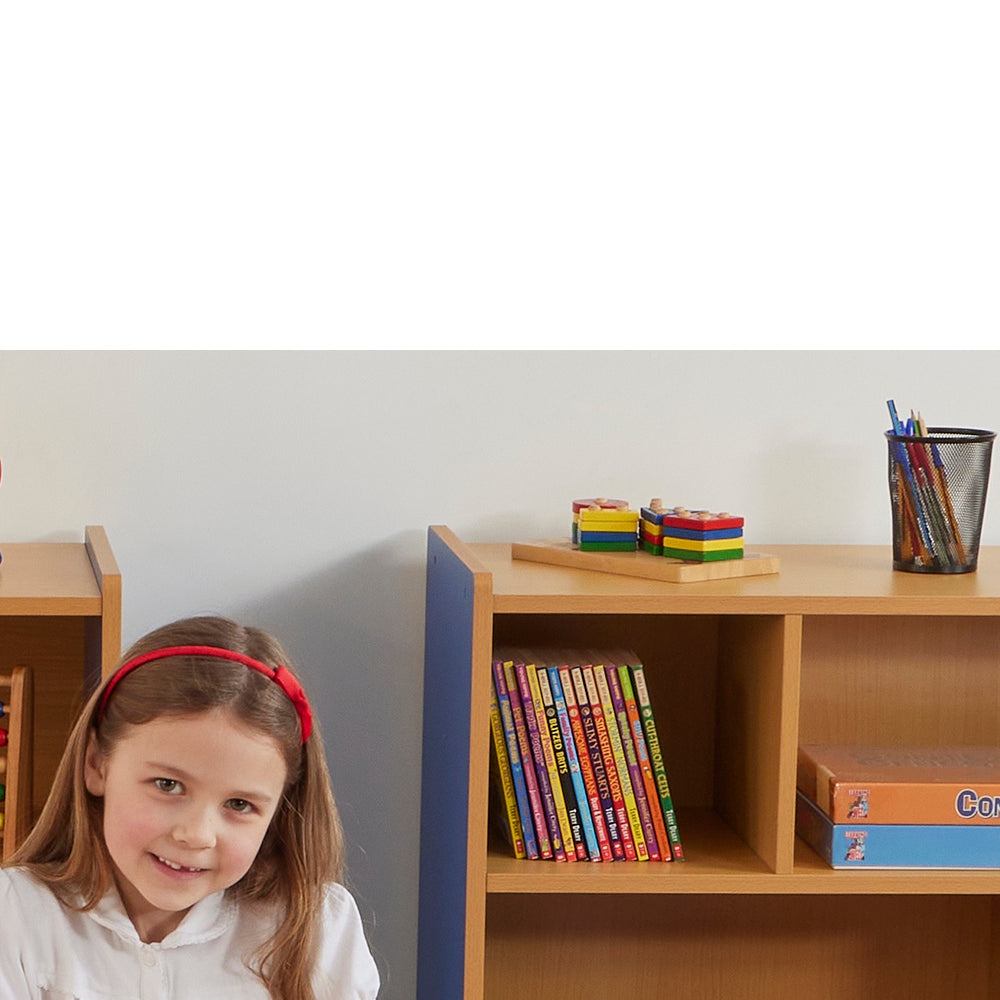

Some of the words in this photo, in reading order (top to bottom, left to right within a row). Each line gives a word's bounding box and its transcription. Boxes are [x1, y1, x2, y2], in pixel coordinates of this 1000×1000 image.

[548, 717, 563, 750] BLITZED
[556, 751, 568, 774] BRITS
[583, 717, 599, 751] SLIMY
[593, 753, 610, 799] STUARTS
[657, 773, 670, 798] CELTS
